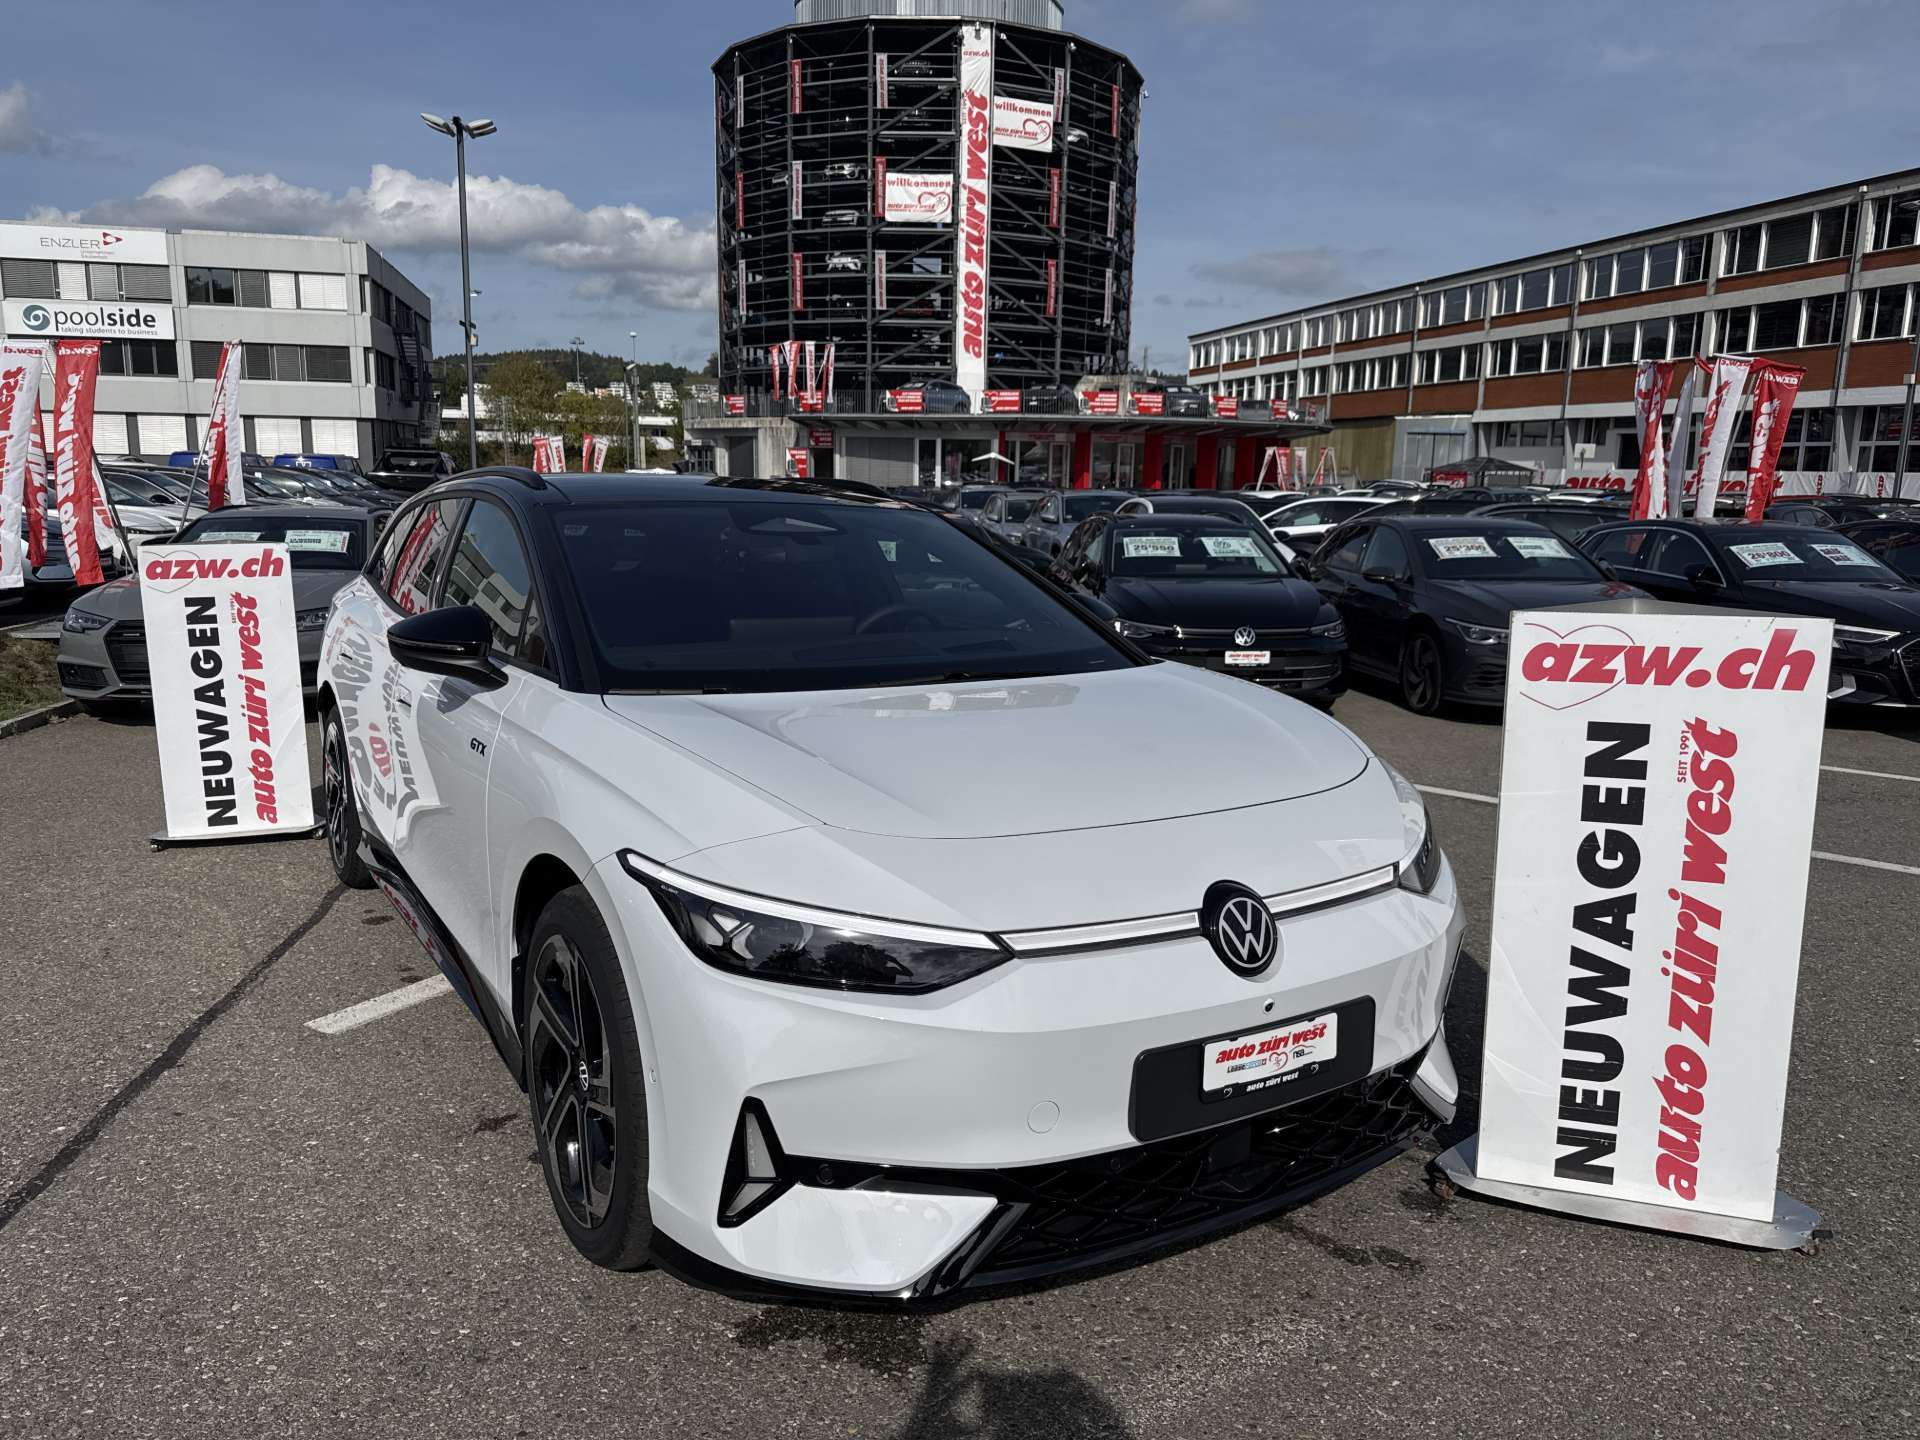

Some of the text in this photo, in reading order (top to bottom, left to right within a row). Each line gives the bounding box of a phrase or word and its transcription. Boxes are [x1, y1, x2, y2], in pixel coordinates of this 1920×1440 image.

[963, 49, 990, 58] azw.ch
[994, 101, 1052, 117] willkommen
[887, 177, 951, 188] willkommen
[960, 88, 988, 359] auto züri west
[40, 237, 100, 249] ENZLER
[54, 307, 156, 332] poolside
[61, 327, 84, 335] taking
[85, 327, 116, 335] students
[145, 548, 284, 581] azw.ch
[1521, 628, 1816, 692] azw.ch
[184, 596, 239, 828] NEUWAGEN
[230, 591, 278, 825] auto züri west
[470, 738, 487, 757] GTX
[1677, 730, 1690, 783] SEIT 1991
[1553, 720, 1652, 1186] NEUWAGEN
[1652, 716, 1739, 1201] auto züri west
[1215, 1043, 1256, 1064] auto
[1256, 1032, 1292, 1055] züri
[1292, 1023, 1328, 1044] west
[1246, 1071, 1299, 1092] auto züri west
